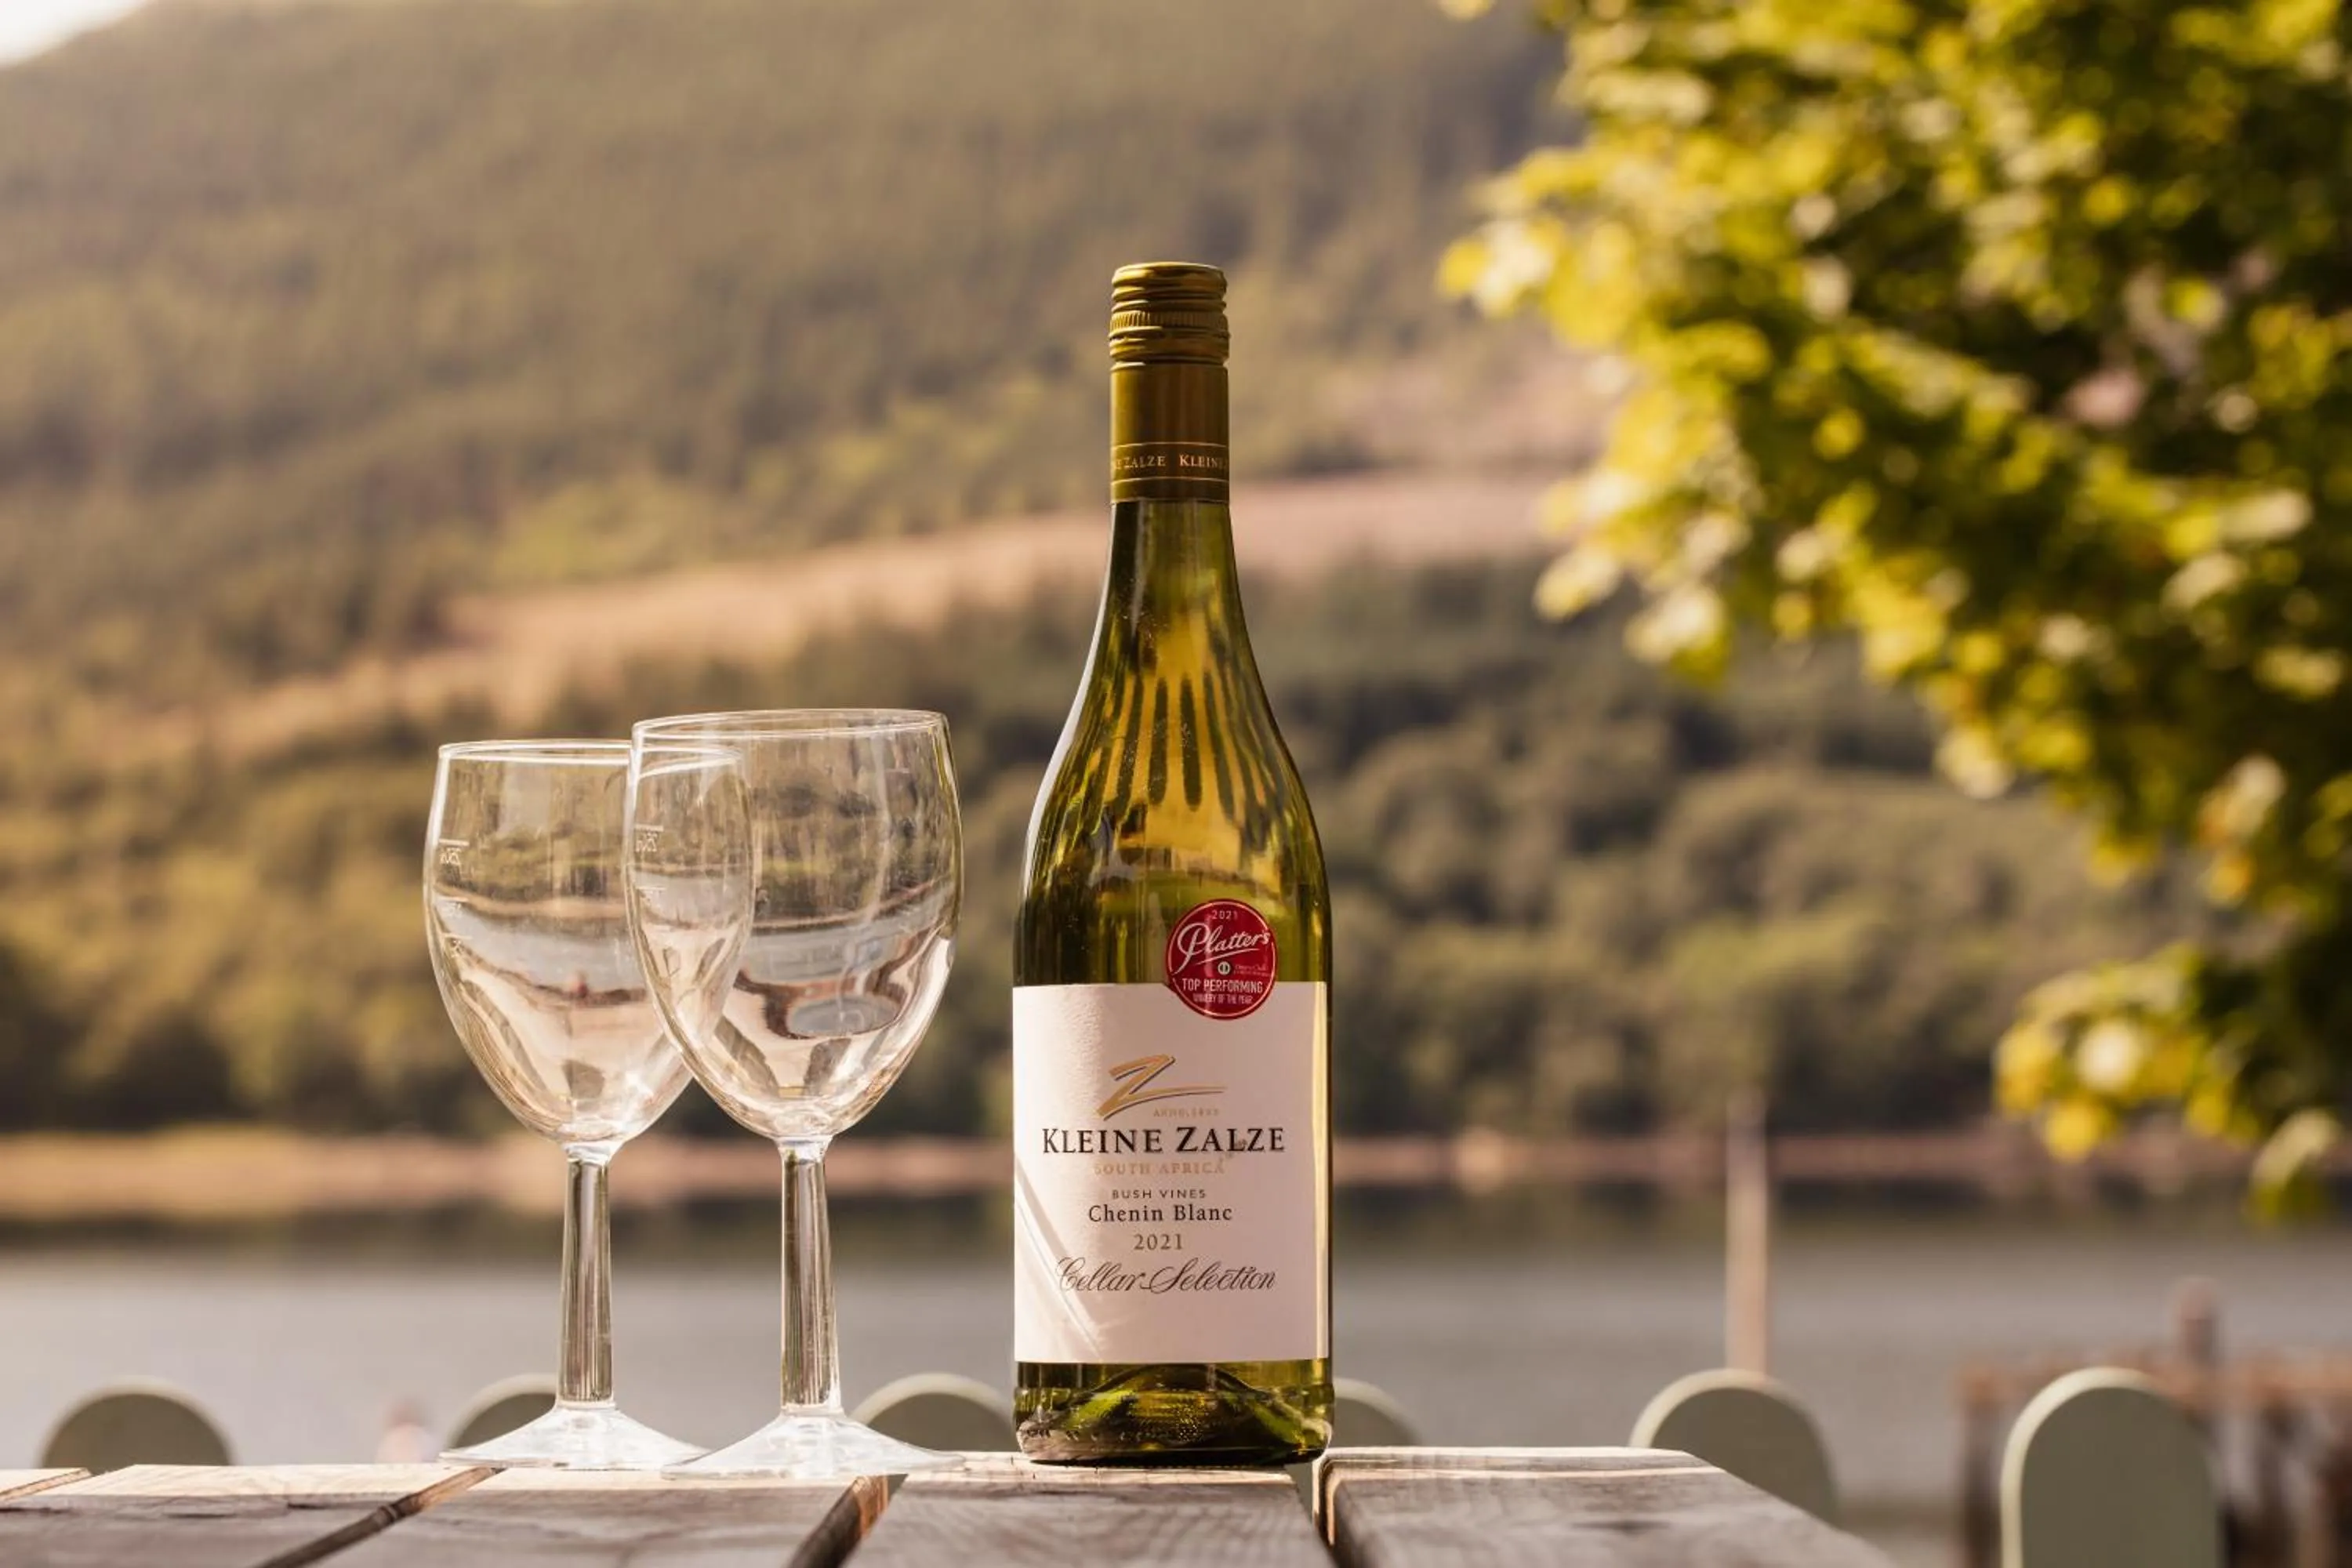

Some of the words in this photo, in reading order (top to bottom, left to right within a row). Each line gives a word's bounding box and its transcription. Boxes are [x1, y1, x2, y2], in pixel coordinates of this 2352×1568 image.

[1211, 910, 1239, 920] 2021
[1173, 922, 1271, 975] Platter's
[1181, 978, 1201, 992] TOP
[1203, 978, 1263, 994] PERFORMING
[1042, 1127, 1163, 1154] KLEINE
[1176, 1126, 1285, 1153] ZALZE
[1094, 1162, 1150, 1175] SOUTH
[1159, 1160, 1226, 1175] AFRICA
[1112, 1189, 1152, 1200] BUSH
[1159, 1189, 1207, 1199] VINES
[1087, 1203, 1163, 1222] Chenin
[1174, 1203, 1233, 1221] Blanc
[1133, 1232, 1184, 1250] 2021
[1056, 1257, 1146, 1292] Cellar
[1139, 1257, 1276, 1294] Selection
